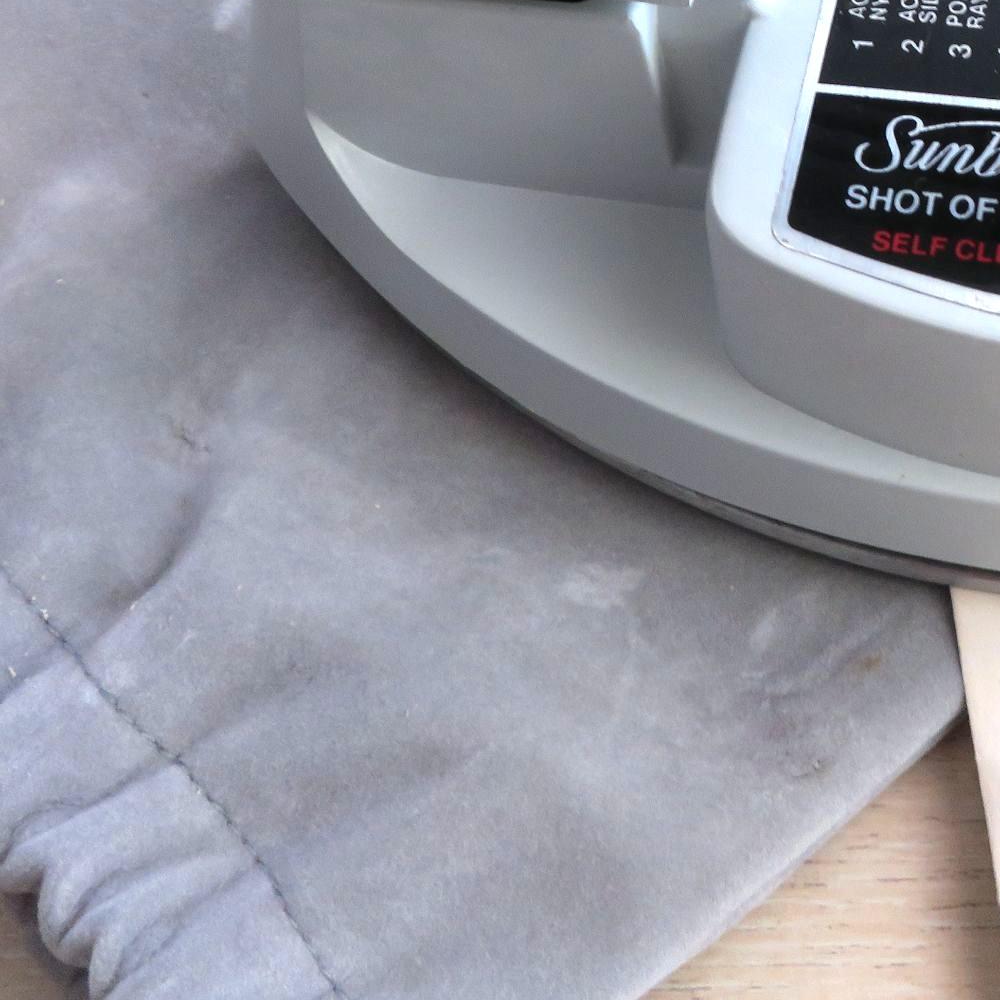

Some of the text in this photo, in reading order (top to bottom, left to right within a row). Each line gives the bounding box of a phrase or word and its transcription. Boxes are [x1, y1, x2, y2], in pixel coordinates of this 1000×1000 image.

[852, 39, 874, 50] 1
[901, 38, 925, 55] 2
[948, 43, 972, 60] 3
[845, 184, 941, 217] SHOT
[949, 194, 998, 222] OF
[872, 230, 950, 257] SELF
